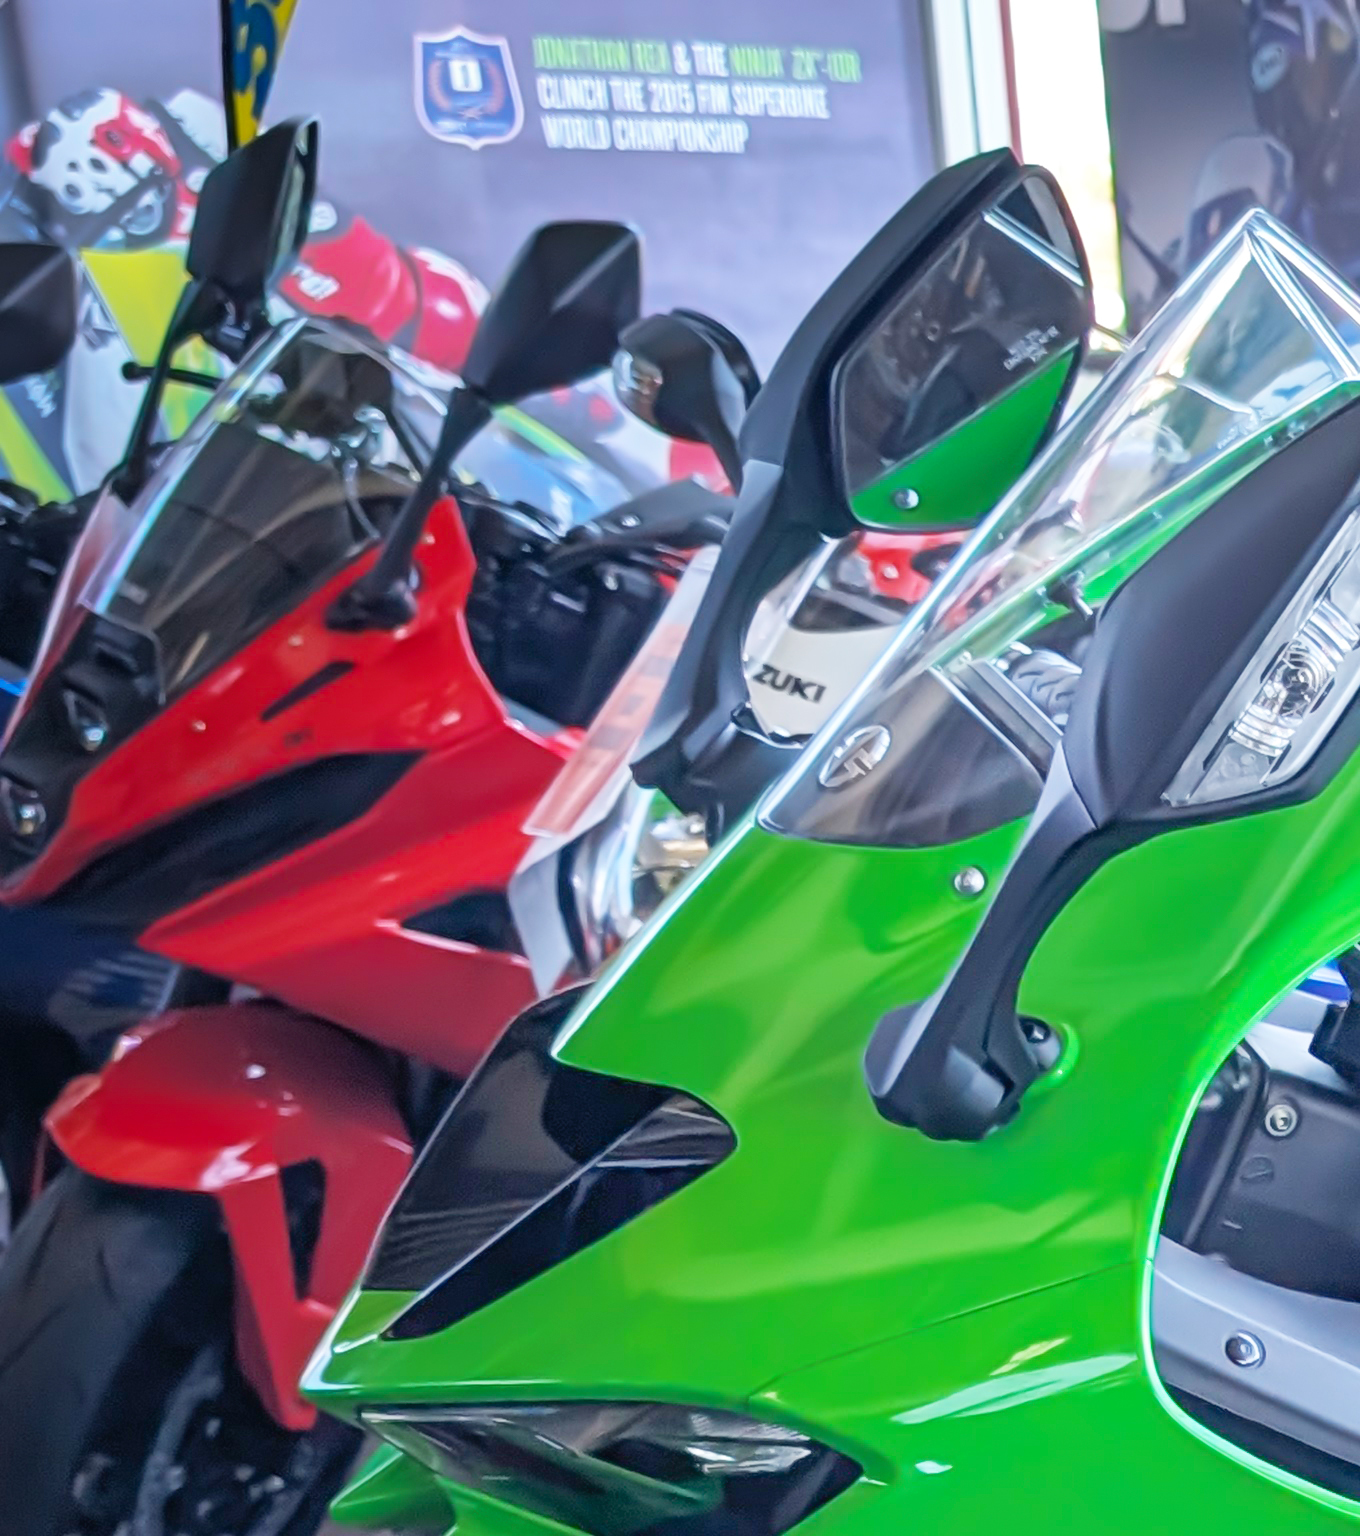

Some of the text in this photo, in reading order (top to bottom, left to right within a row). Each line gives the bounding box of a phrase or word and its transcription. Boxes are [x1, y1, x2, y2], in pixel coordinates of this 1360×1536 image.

[673, 42, 692, 75] &
[692, 43, 729, 77] THE
[536, 75, 609, 111] CLINCH
[609, 78, 647, 113] THE
[649, 80, 695, 114] 2015
[541, 115, 749, 154] WORLD CHAMPIONSHIP
[752, 663, 827, 704] ZUKI
